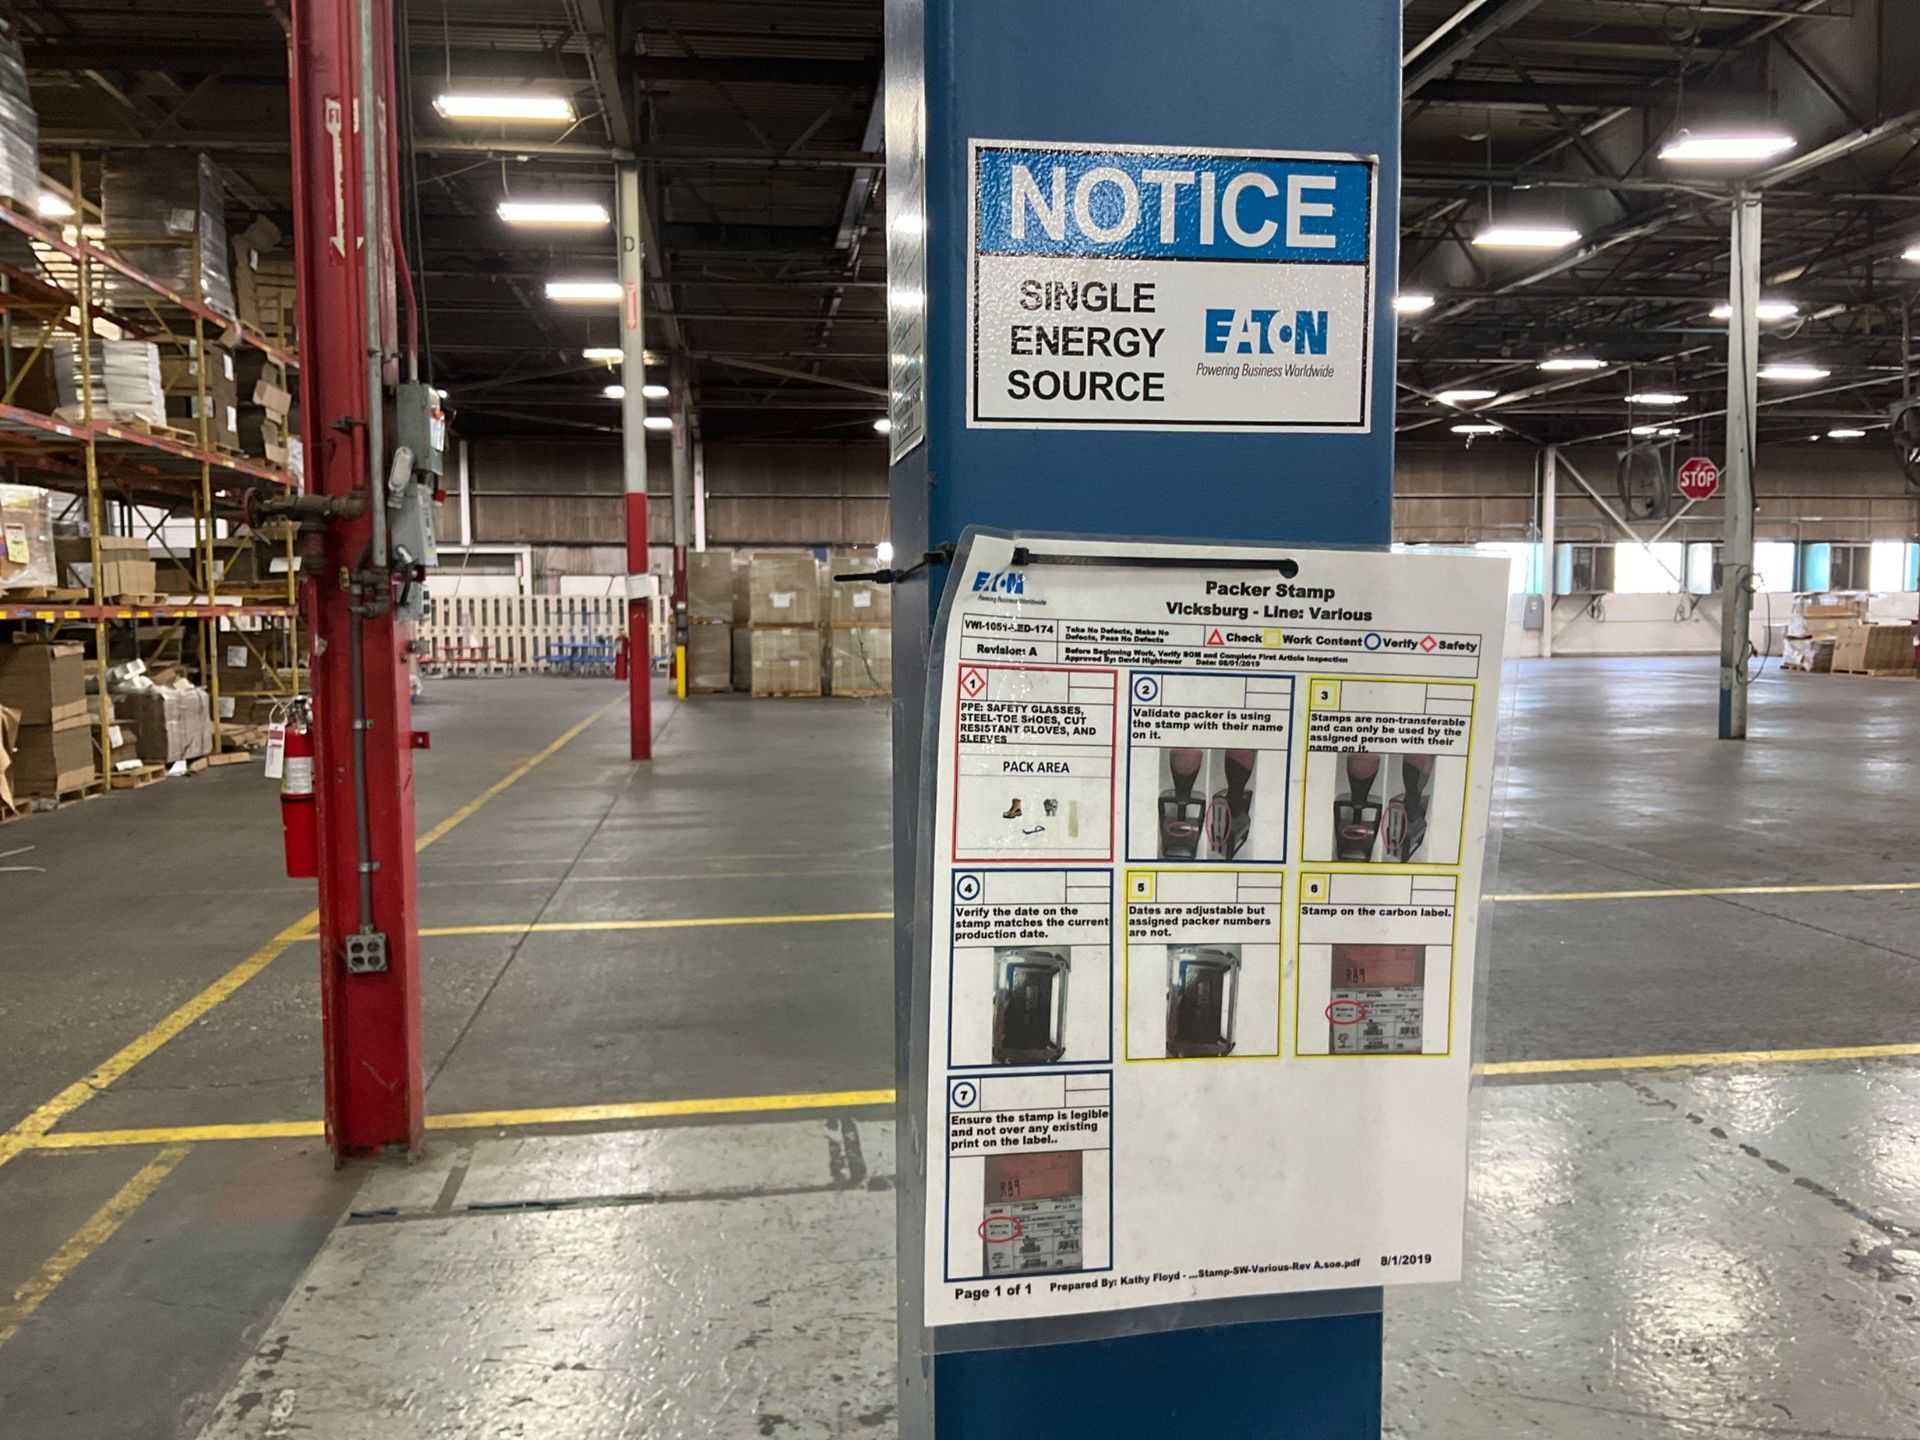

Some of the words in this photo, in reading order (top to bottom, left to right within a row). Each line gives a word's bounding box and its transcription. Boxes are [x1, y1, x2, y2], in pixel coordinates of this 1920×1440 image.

[1010, 165, 1336, 249] NOTICE
[1019, 280, 1155, 313] SINGLE
[1205, 309, 1328, 355] EATON
[1010, 326, 1165, 358] ENERGY
[1196, 362, 1239, 379] Powering
[1241, 363, 1282, 377] Business
[1284, 364, 1334, 378] Worldwide
[1007, 370, 1165, 402] SOURCE
[1680, 470, 1716, 488] STOP
[1206, 581, 1270, 597] Packer
[1275, 583, 1335, 601] Stamp
[1166, 602, 1248, 620] Vicksburg
[1264, 605, 1304, 619] Line:
[1309, 606, 1373, 622] Various
[1087, 626, 1098, 634] No
[1226, 633, 1263, 643] Check
[1283, 634, 1312, 645] Work
[1316, 636, 1363, 646] Content
[1383, 638, 1418, 650] Verify
[1438, 640, 1478, 653] Safety
[977, 643, 1026, 657] Revision:
[1029, 646, 1038, 657] A
[1220, 652, 1257, 661] Complete
[1306, 656, 1348, 664] Inspection
[969, 679, 976, 688] 1
[1141, 686, 1150, 695] 2
[1321, 690, 1329, 700] 3
[960, 702, 983, 712] PPE:
[986, 703, 1028, 714] SAFETY
[1031, 705, 1084, 716] GLASSES,
[960, 713, 1018, 723] STEEL-TOE
[1021, 714, 1061, 726] SHOES,
[1064, 716, 1087, 725] CUT
[1133, 708, 1181, 719] Validate
[1184, 711, 1223, 721] packer
[1226, 711, 1237, 720] is
[1240, 711, 1271, 723] using
[1311, 713, 1351, 723] Stamps
[1355, 715, 1372, 723] are
[1375, 716, 1466, 727] non-transferable
[960, 724, 1020, 734] RESISTANT
[1023, 725, 1070, 737] GLOVES,
[1073, 726, 1097, 736] AND
[1132, 719, 1151, 728] the
[1155, 721, 1190, 731] stamp
[1193, 721, 1218, 730] with
[1222, 722, 1248, 731] their
[1252, 724, 1284, 732] name
[1310, 724, 1330, 733] and
[1333, 725, 1353, 733] can
[1356, 725, 1379, 735] only
[1382, 726, 1395, 734] be
[1398, 726, 1424, 735] used
[1427, 727, 1440, 736] by
[1443, 727, 1462, 736] the
[959, 734, 1007, 744] SLEEVES
[1132, 731, 1146, 739] on
[1149, 730, 1161, 740] it.
[1309, 734, 1358, 745] assigned
[1361, 736, 1398, 746] person
[1400, 736, 1424, 745] with
[1427, 737, 1454, 746] their
[1358, 744, 1369, 753] it.
[1003, 761, 1034, 773] PACK
[1037, 761, 1070, 773] AREA
[964, 884, 973, 893] 4
[1137, 883, 1145, 892] 5
[1310, 884, 1318, 893] 6
[955, 907, 989, 918] Verify
[992, 907, 1011, 916] the
[1014, 907, 1040, 916] date
[1043, 908, 1057, 916] on
[1060, 906, 1079, 915] the
[1129, 906, 1161, 915] Dates
[1164, 907, 1182, 915] are
[1185, 906, 1244, 917] adjustable
[1247, 906, 1265, 915] but
[1301, 907, 1337, 917] Stamp
[1341, 908, 1355, 916] on
[1358, 907, 1376, 916] the
[1379, 907, 1417, 917] carbon
[1421, 908, 1452, 917] label.
[955, 919, 991, 930] stamp
[994, 918, 1043, 927] matches
[1047, 918, 1065, 927] the
[1068, 918, 1109, 927] current
[1129, 917, 1178, 928] assigned
[1181, 917, 1220, 928] packer
[1223, 917, 1271, 926] numbers
[955, 930, 1016, 941] production
[1020, 929, 1049, 939] date.
[1129, 929, 1147, 937] are
[1150, 928, 1172, 937] not.
[960, 1090, 968, 1101] 7
[951, 1116, 992, 1126] Ensure
[996, 1113, 1015, 1123] the
[1018, 1112, 1054, 1123] stamp
[1057, 1112, 1067, 1121] is
[1071, 1110, 1109, 1122] legible
[951, 1127, 973, 1137] and
[976, 1126, 996, 1136] not
[999, 1126, 1025, 1135] over
[1028, 1125, 1049, 1136] any
[1052, 1121, 1098, 1134] existing
[951, 1138, 980, 1151] print
[983, 1138, 997, 1147] on
[1000, 1136, 1020, 1146] the
[1380, 1254, 1432, 1266] 8/1/2019
[1050, 1281, 1098, 1293] Prepared
[1101, 1279, 1117, 1289] By:
[1120, 1276, 1150, 1286] Kathy
[1153, 1272, 1181, 1283] Floyd
[955, 1287, 989, 1300] Page
[994, 1286, 1001, 1297] 1
[1007, 1284, 1021, 1296] of
[1025, 1284, 1032, 1295] 1
